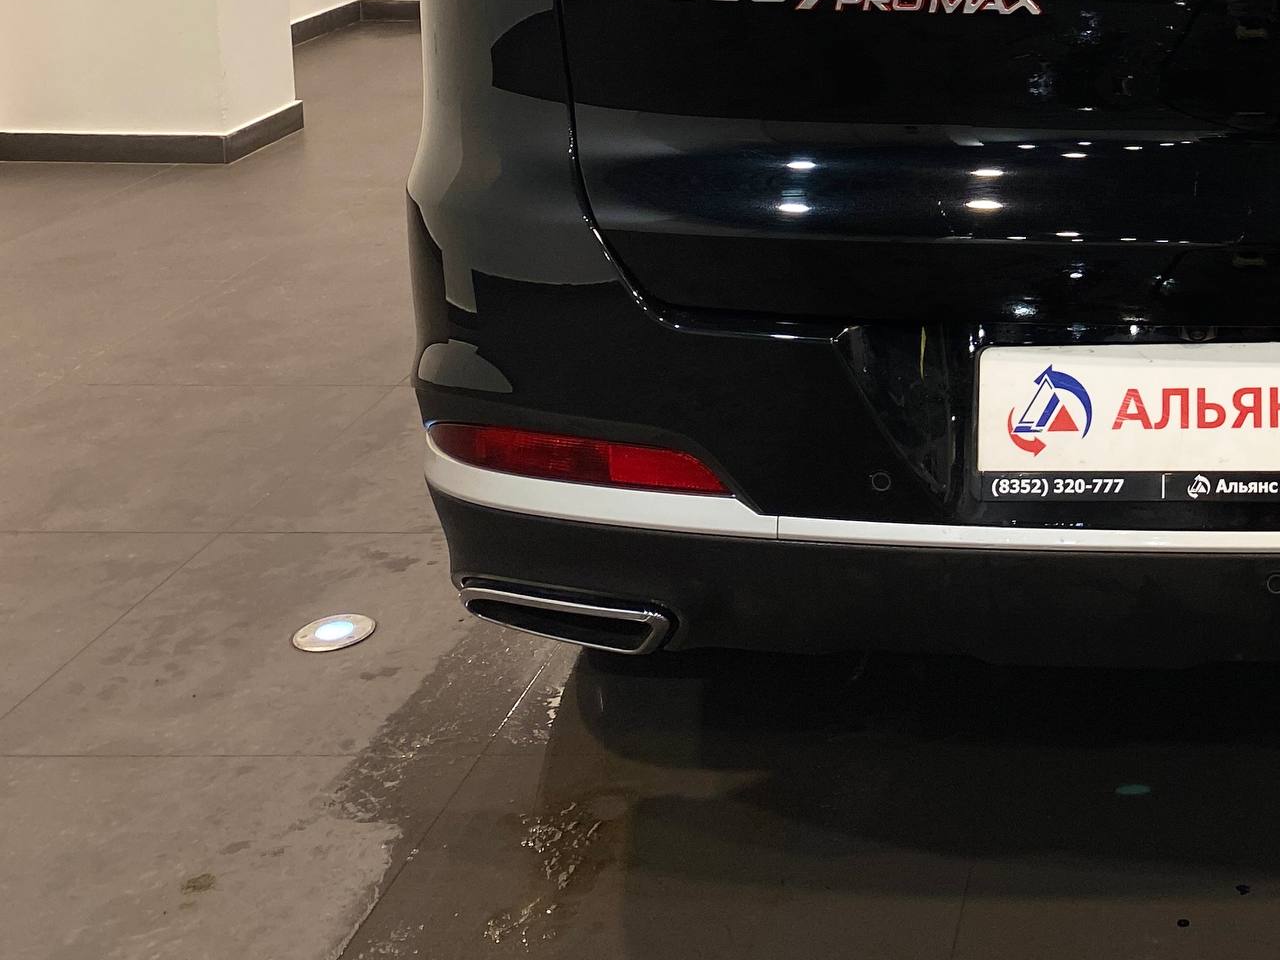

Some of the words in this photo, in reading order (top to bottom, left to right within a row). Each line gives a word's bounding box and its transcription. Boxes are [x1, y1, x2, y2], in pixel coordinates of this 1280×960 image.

[991, 477, 1049, 497] (8352)
[1053, 478, 1124, 495] 320-777
[1215, 478, 1278, 496] Альянс
